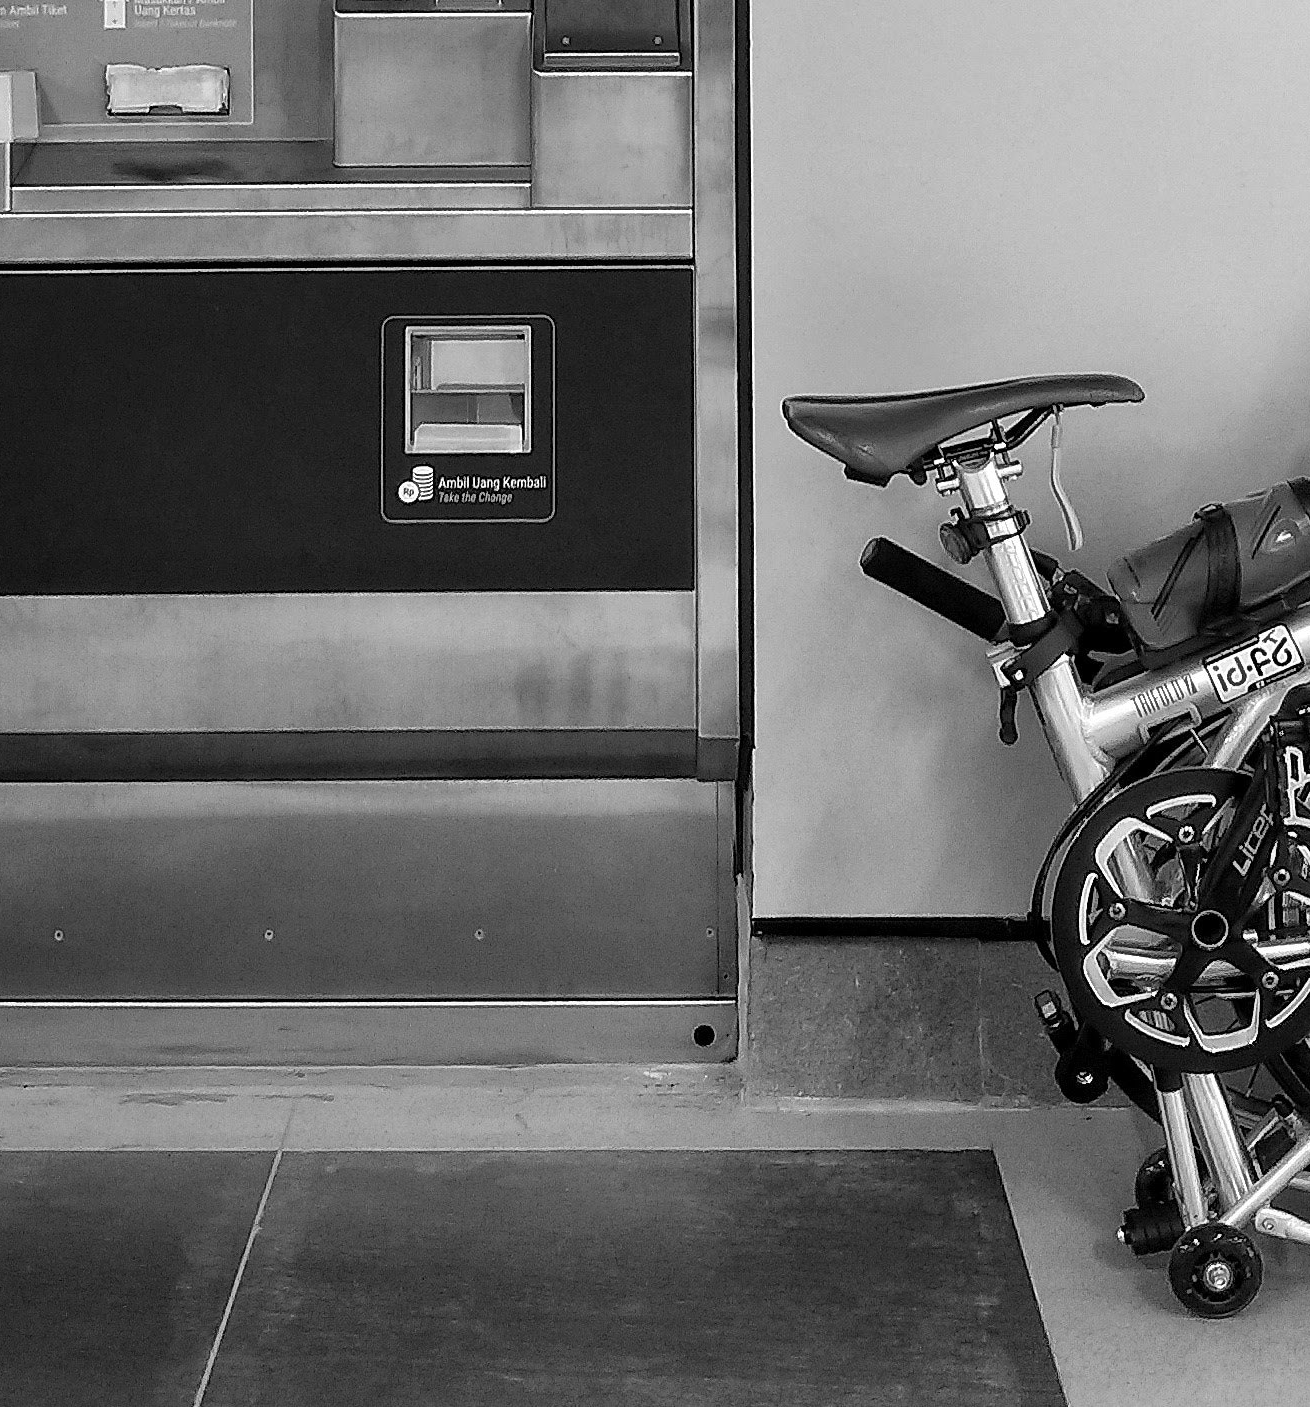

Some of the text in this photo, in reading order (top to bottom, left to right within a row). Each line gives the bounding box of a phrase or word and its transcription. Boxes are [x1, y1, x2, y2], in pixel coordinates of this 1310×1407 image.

[9, 4, 39, 16] Ambil
[41, 3, 68, 16] Tiket
[134, 5, 196, 18] Uang Kertas
[438, 475, 547, 492] Ambil Uang Kembali
[438, 491, 513, 505] Take the Change
[1130, 676, 1185, 719] TRIFOLD
